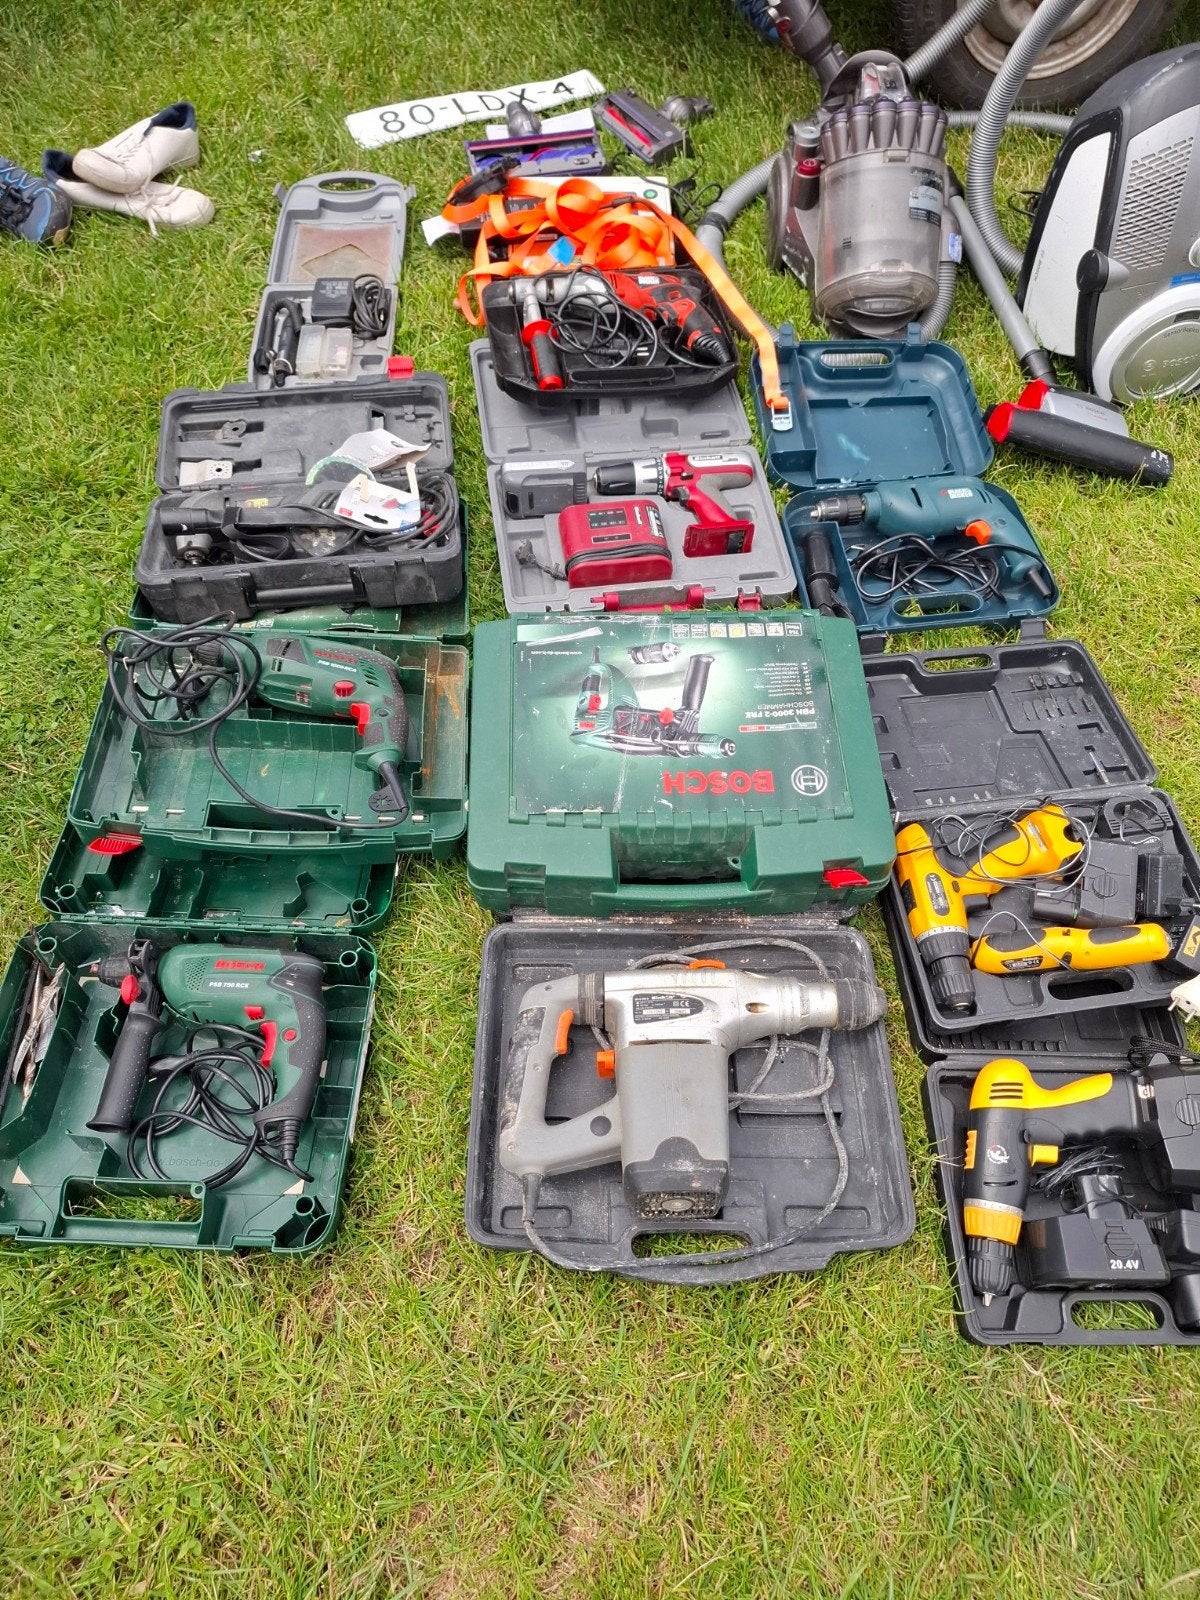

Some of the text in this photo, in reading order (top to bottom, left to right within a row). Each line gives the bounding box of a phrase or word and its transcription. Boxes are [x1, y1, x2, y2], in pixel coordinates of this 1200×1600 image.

[379, 81, 574, 133] 80-LDX-4
[744, 707, 816, 719] PBH 3000-2 FRE
[663, 770, 775, 795] BOSCH
[215, 960, 265, 971] BOSCH
[1109, 1259, 1139, 1270] 20.4V
